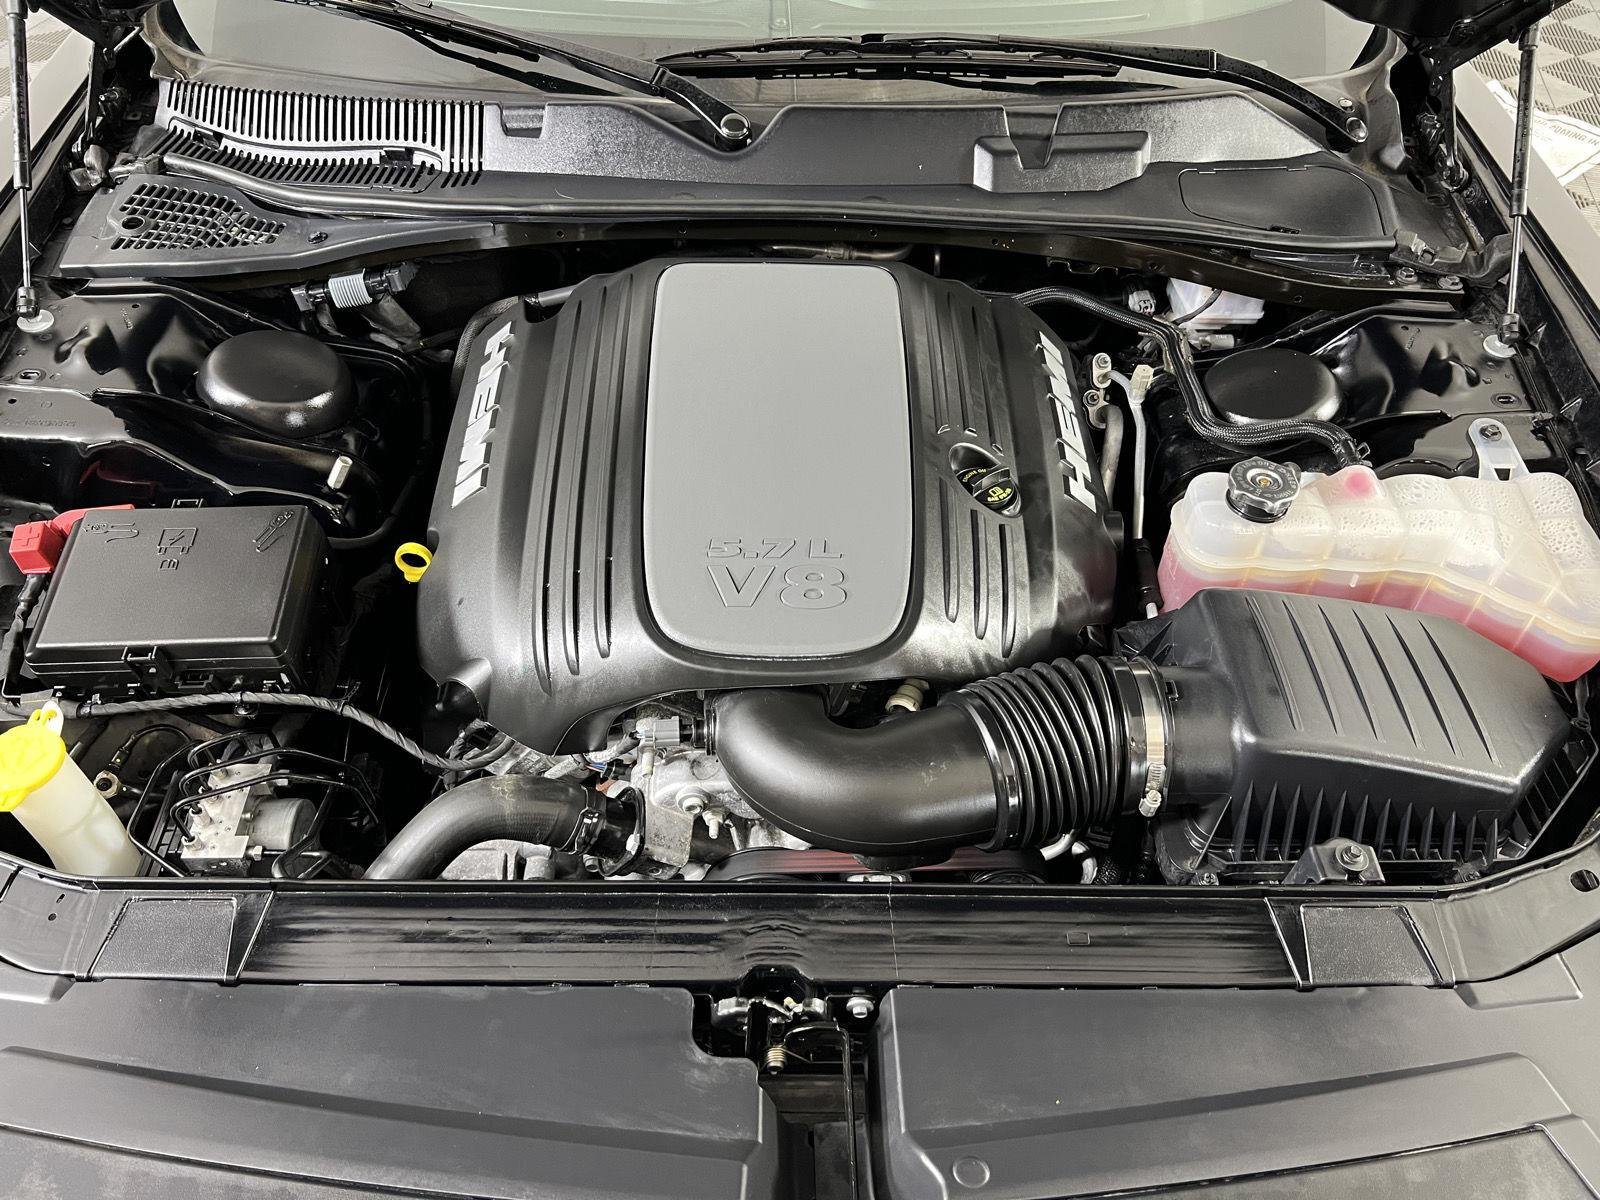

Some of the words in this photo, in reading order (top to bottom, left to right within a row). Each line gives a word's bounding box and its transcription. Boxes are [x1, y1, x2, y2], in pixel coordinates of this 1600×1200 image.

[451, 321, 515, 509] HEMI
[1038, 330, 1097, 514] HEMI
[706, 537, 798, 560] 5.7
[808, 537, 844, 560] L
[706, 564, 848, 610] V8
